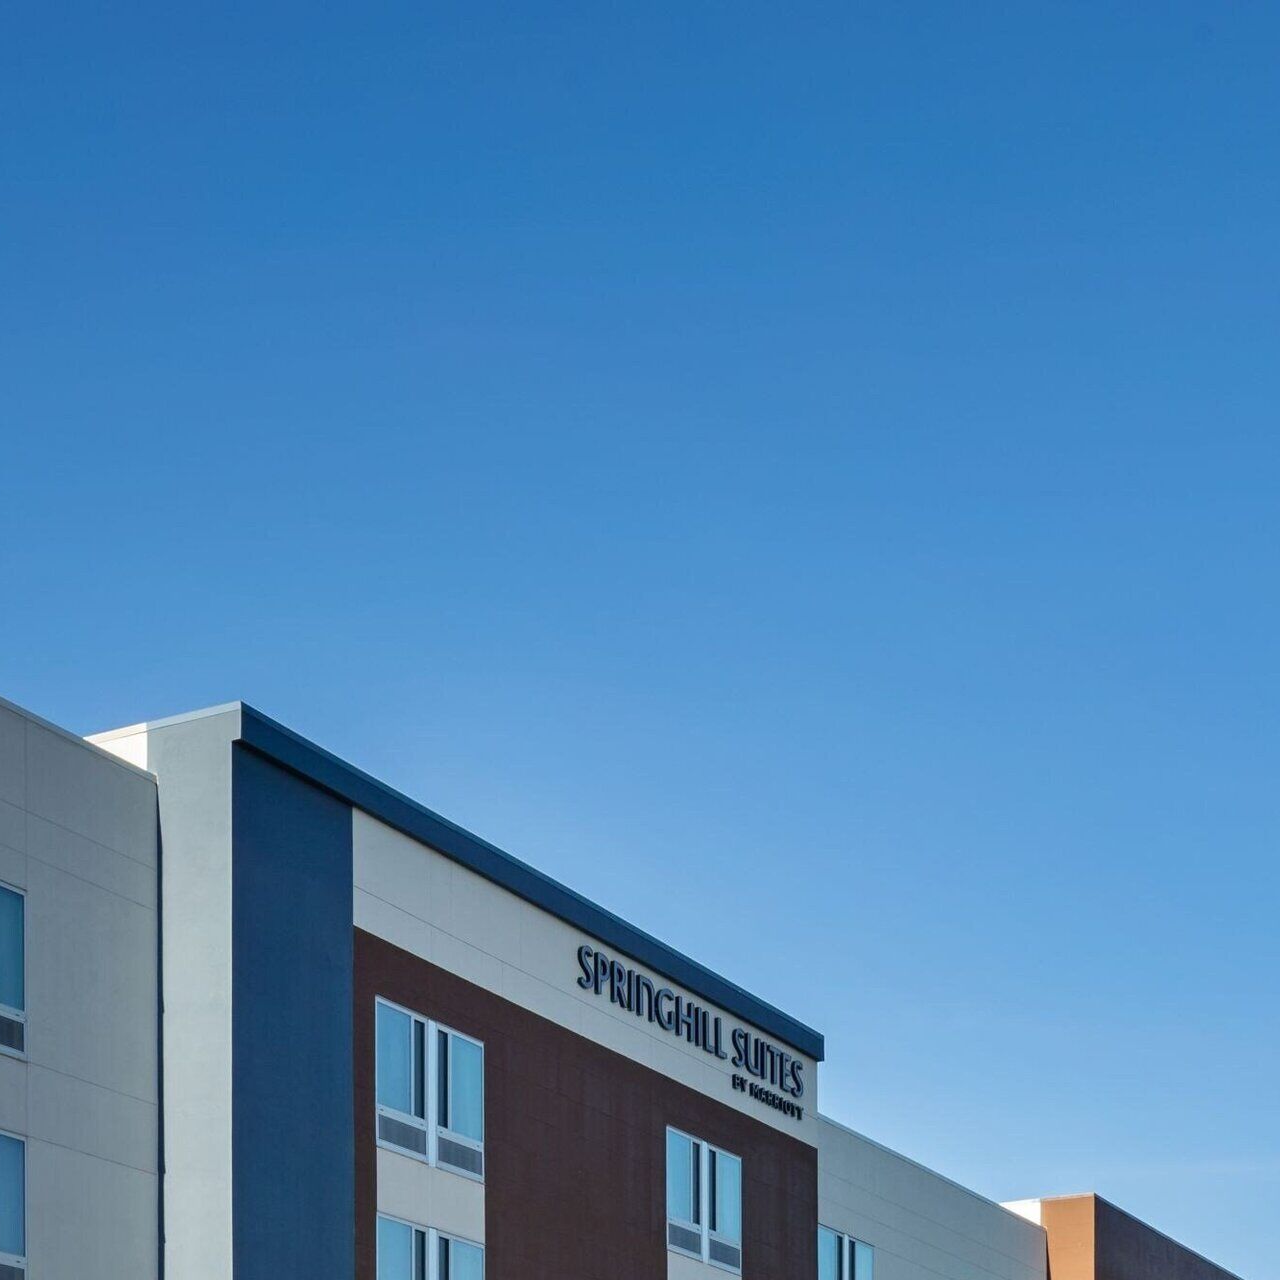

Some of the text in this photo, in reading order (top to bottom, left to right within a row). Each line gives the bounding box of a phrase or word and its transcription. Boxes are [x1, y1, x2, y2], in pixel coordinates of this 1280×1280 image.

[577, 944, 804, 1098] SPRINGHILL SUITES
[731, 1073, 749, 1093] BY
